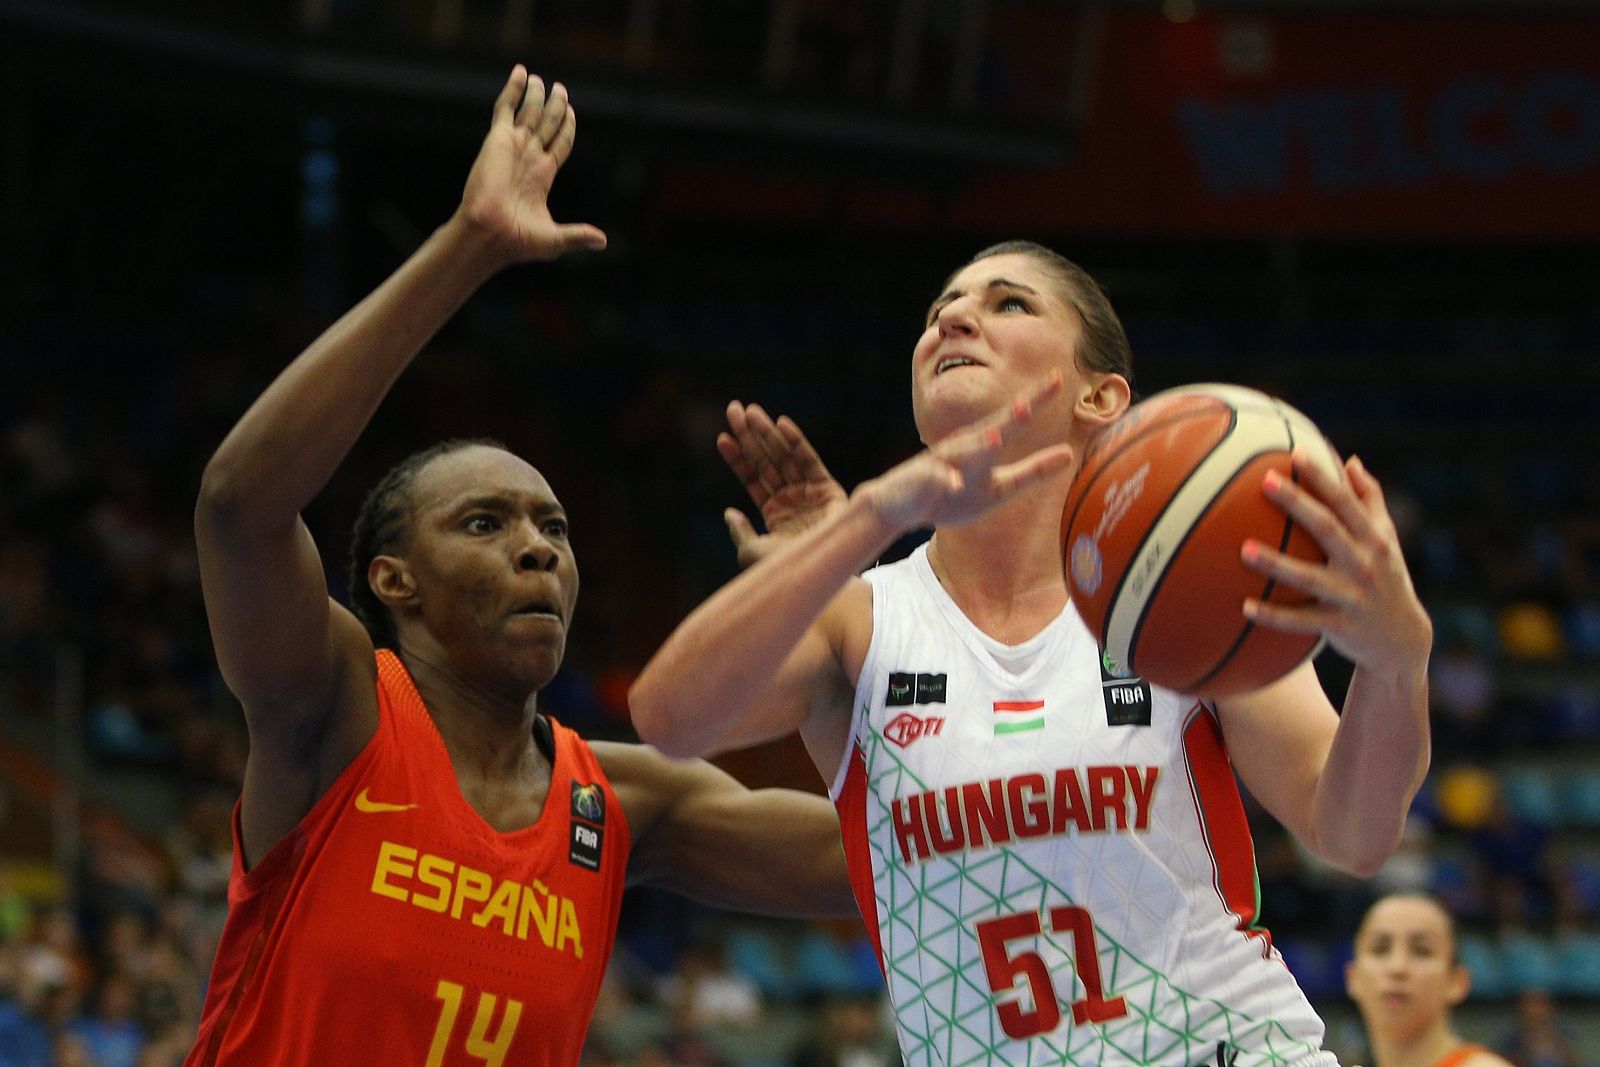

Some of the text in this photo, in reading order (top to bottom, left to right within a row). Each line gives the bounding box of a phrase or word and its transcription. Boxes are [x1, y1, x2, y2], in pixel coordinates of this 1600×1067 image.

[1111, 686, 1144, 704] FIBA
[575, 825, 598, 848] FIBA
[891, 765, 1160, 866] HUNGARY
[371, 841, 584, 959] ESPAÑA
[973, 906, 1129, 1041] 51
[425, 980, 523, 1067] 14
